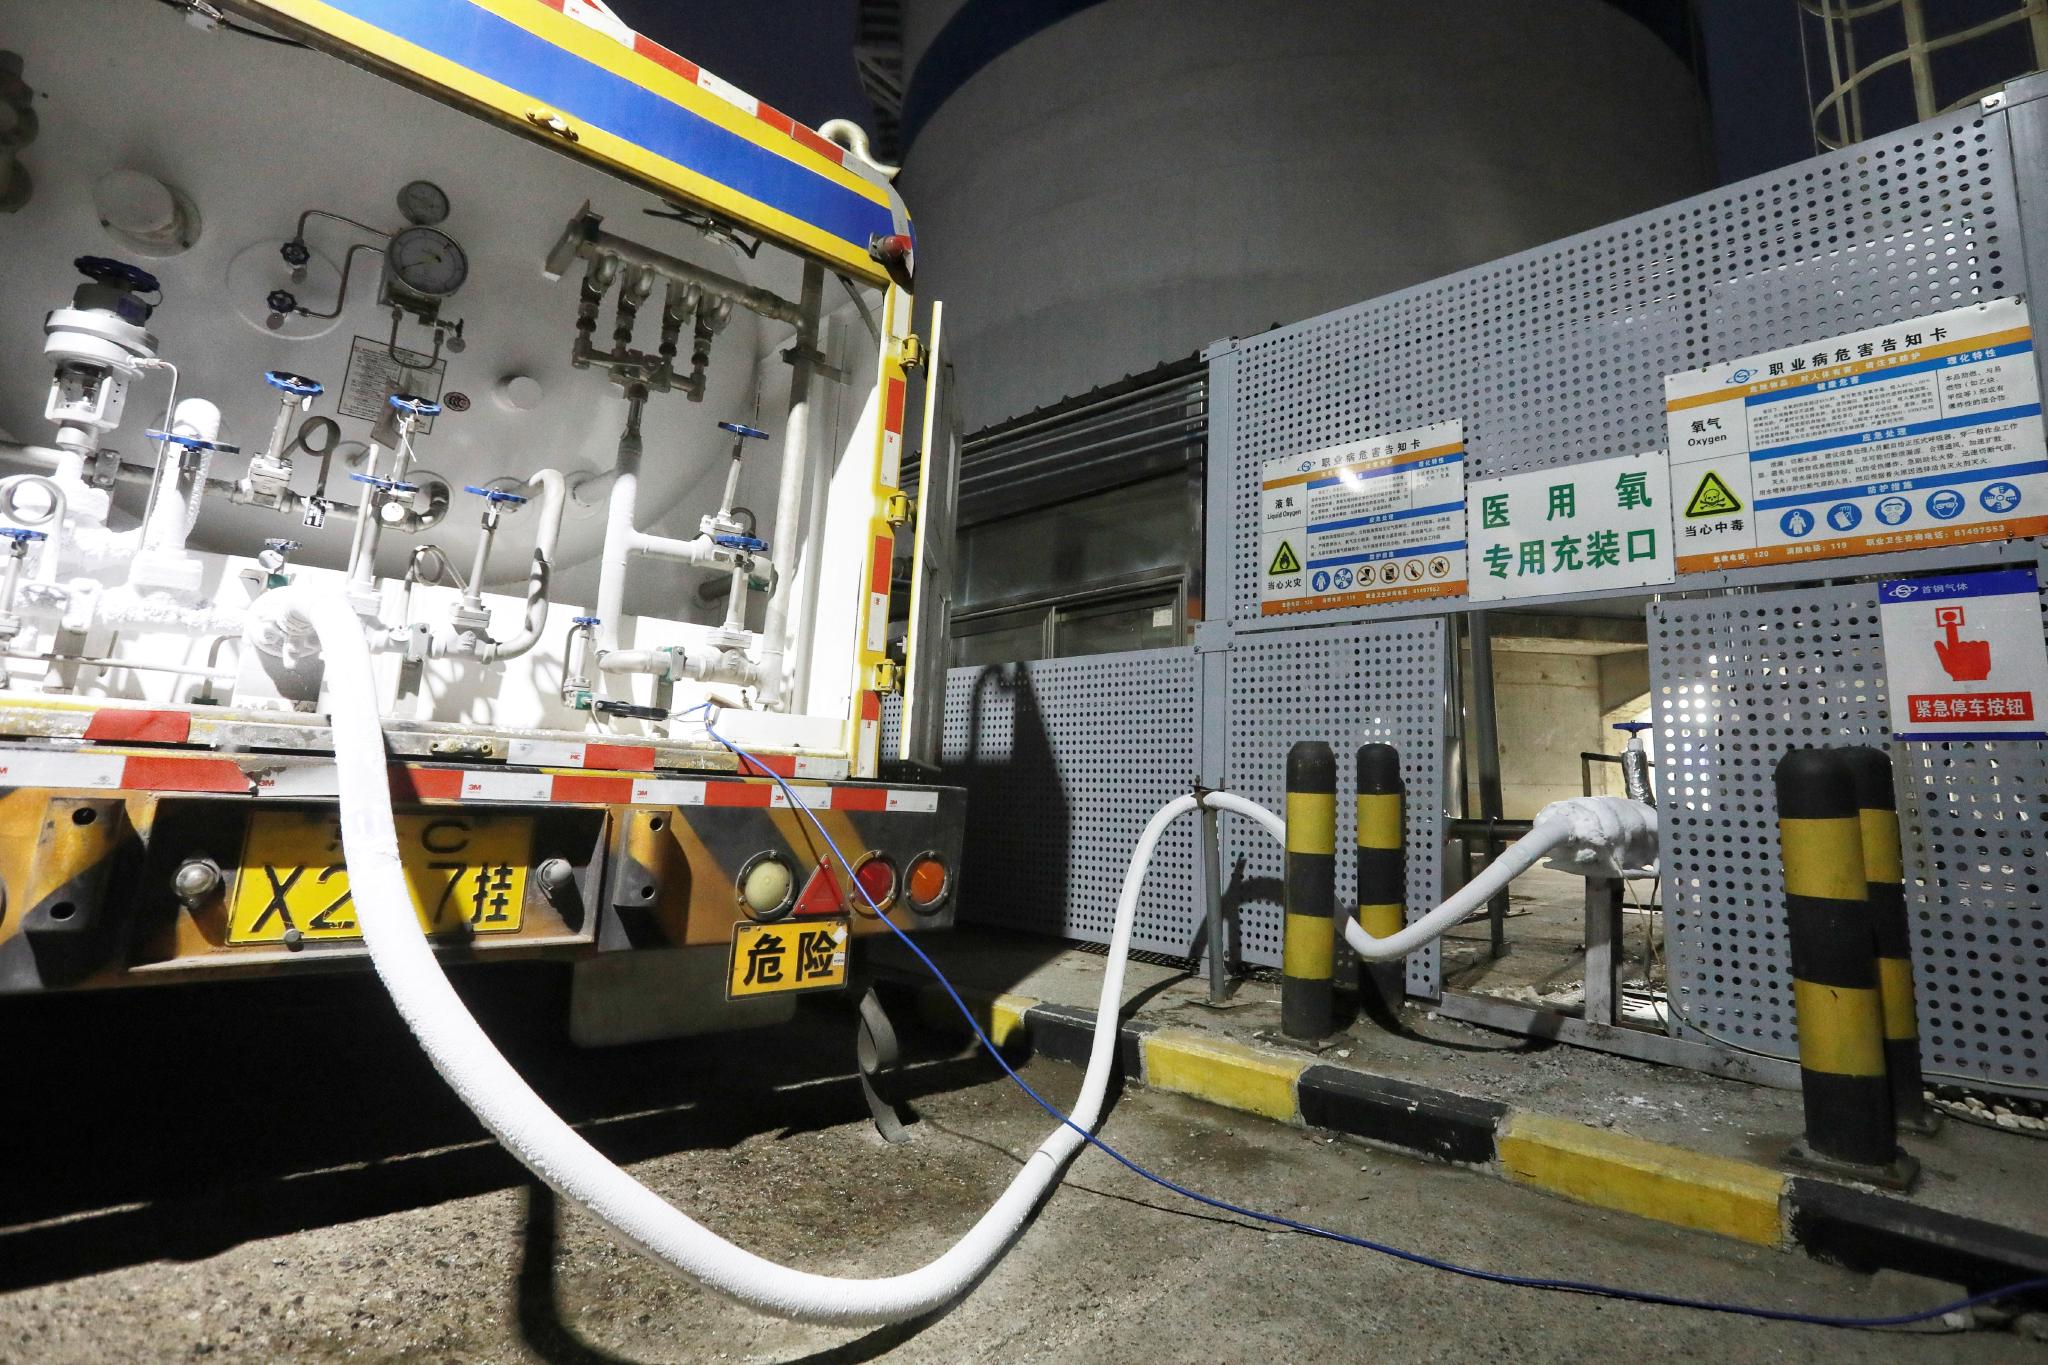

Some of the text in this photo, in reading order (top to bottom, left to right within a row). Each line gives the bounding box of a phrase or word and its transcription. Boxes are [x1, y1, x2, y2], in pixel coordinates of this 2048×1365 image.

[1769, 327, 1947, 376] 职业病危害告知卡
[1946, 348, 1997, 365] 理化特性
[1691, 417, 1722, 433] 氧气
[1688, 434, 1727, 446] Oxygen
[1862, 428, 1907, 442] 应急处理
[1321, 438, 1421, 467] 职业病危害告知卡
[1867, 481, 1913, 494] 防护措施
[1275, 497, 1293, 508] 液氧
[1482, 471, 1652, 530] 医用氧
[1268, 510, 1302, 520] Liquid Oxygen
[1685, 519, 1744, 537] 当心中毒
[1483, 528, 1657, 580] 专用充装口
[1267, 578, 1302, 590] 当心火灾
[1921, 583, 1968, 594] 首钢气体
[1916, 698, 2026, 718] 紧急停车按钮
[257, 778, 275, 787] 3M
[250, 863, 512, 933] X27挂
[743, 930, 839, 986] 危险
